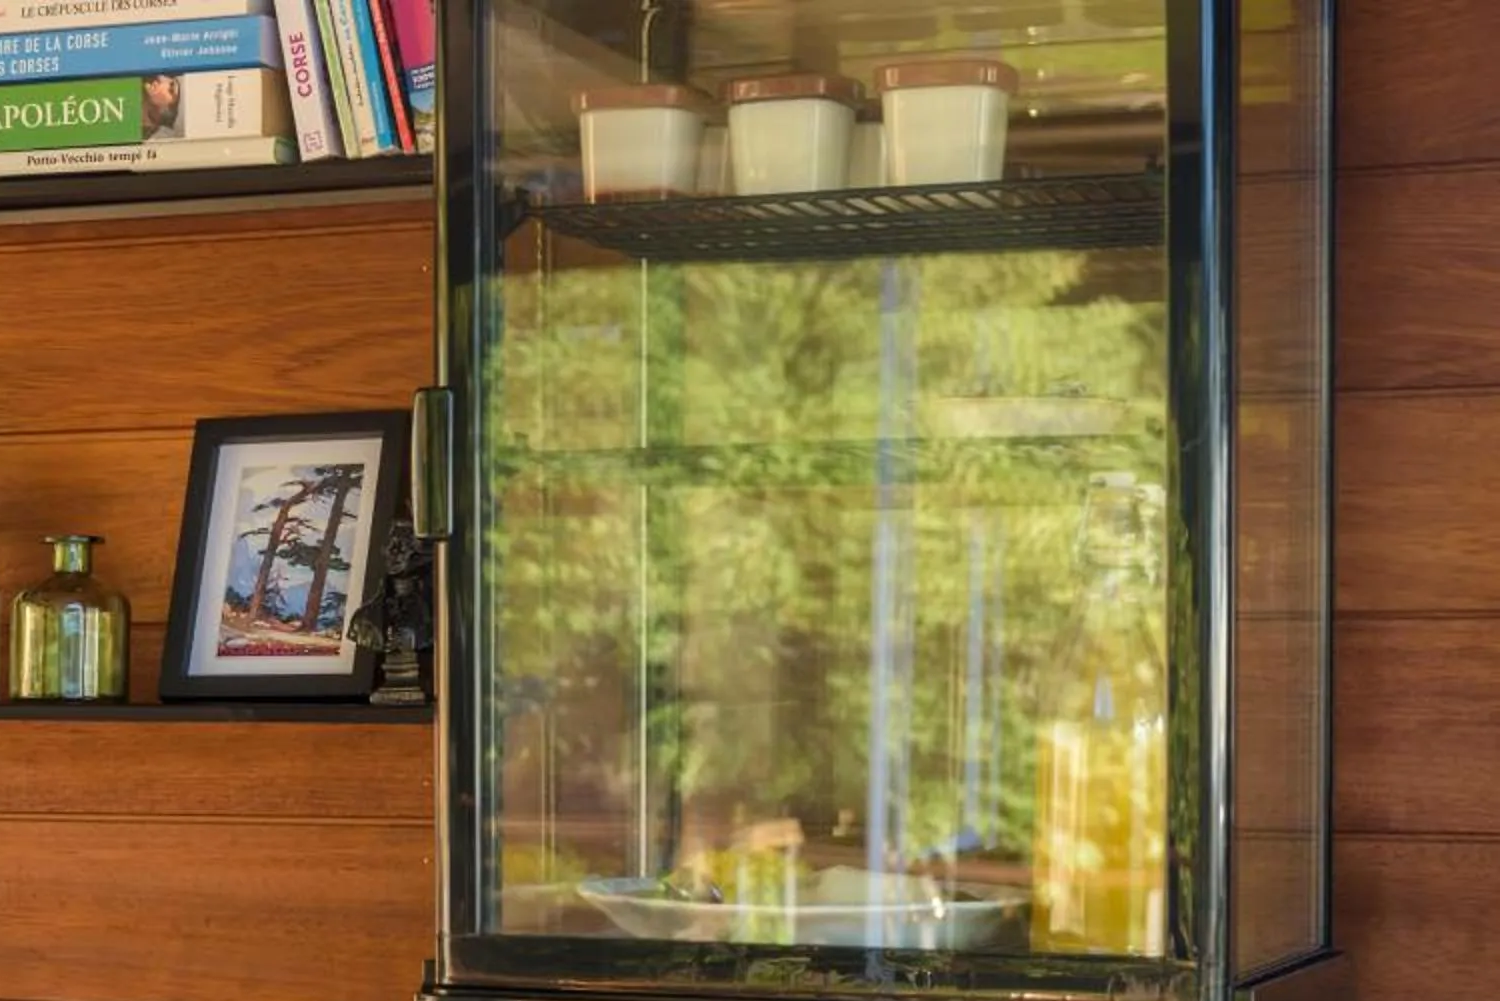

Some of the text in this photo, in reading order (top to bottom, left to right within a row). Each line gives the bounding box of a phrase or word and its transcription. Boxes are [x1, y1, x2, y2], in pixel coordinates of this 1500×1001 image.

[25, 37, 40, 53] DE
[45, 35, 61, 50] LA
[67, 32, 109, 49] CORSE
[11, 56, 60, 75] CORSES
[289, 31, 312, 98] CORSE
